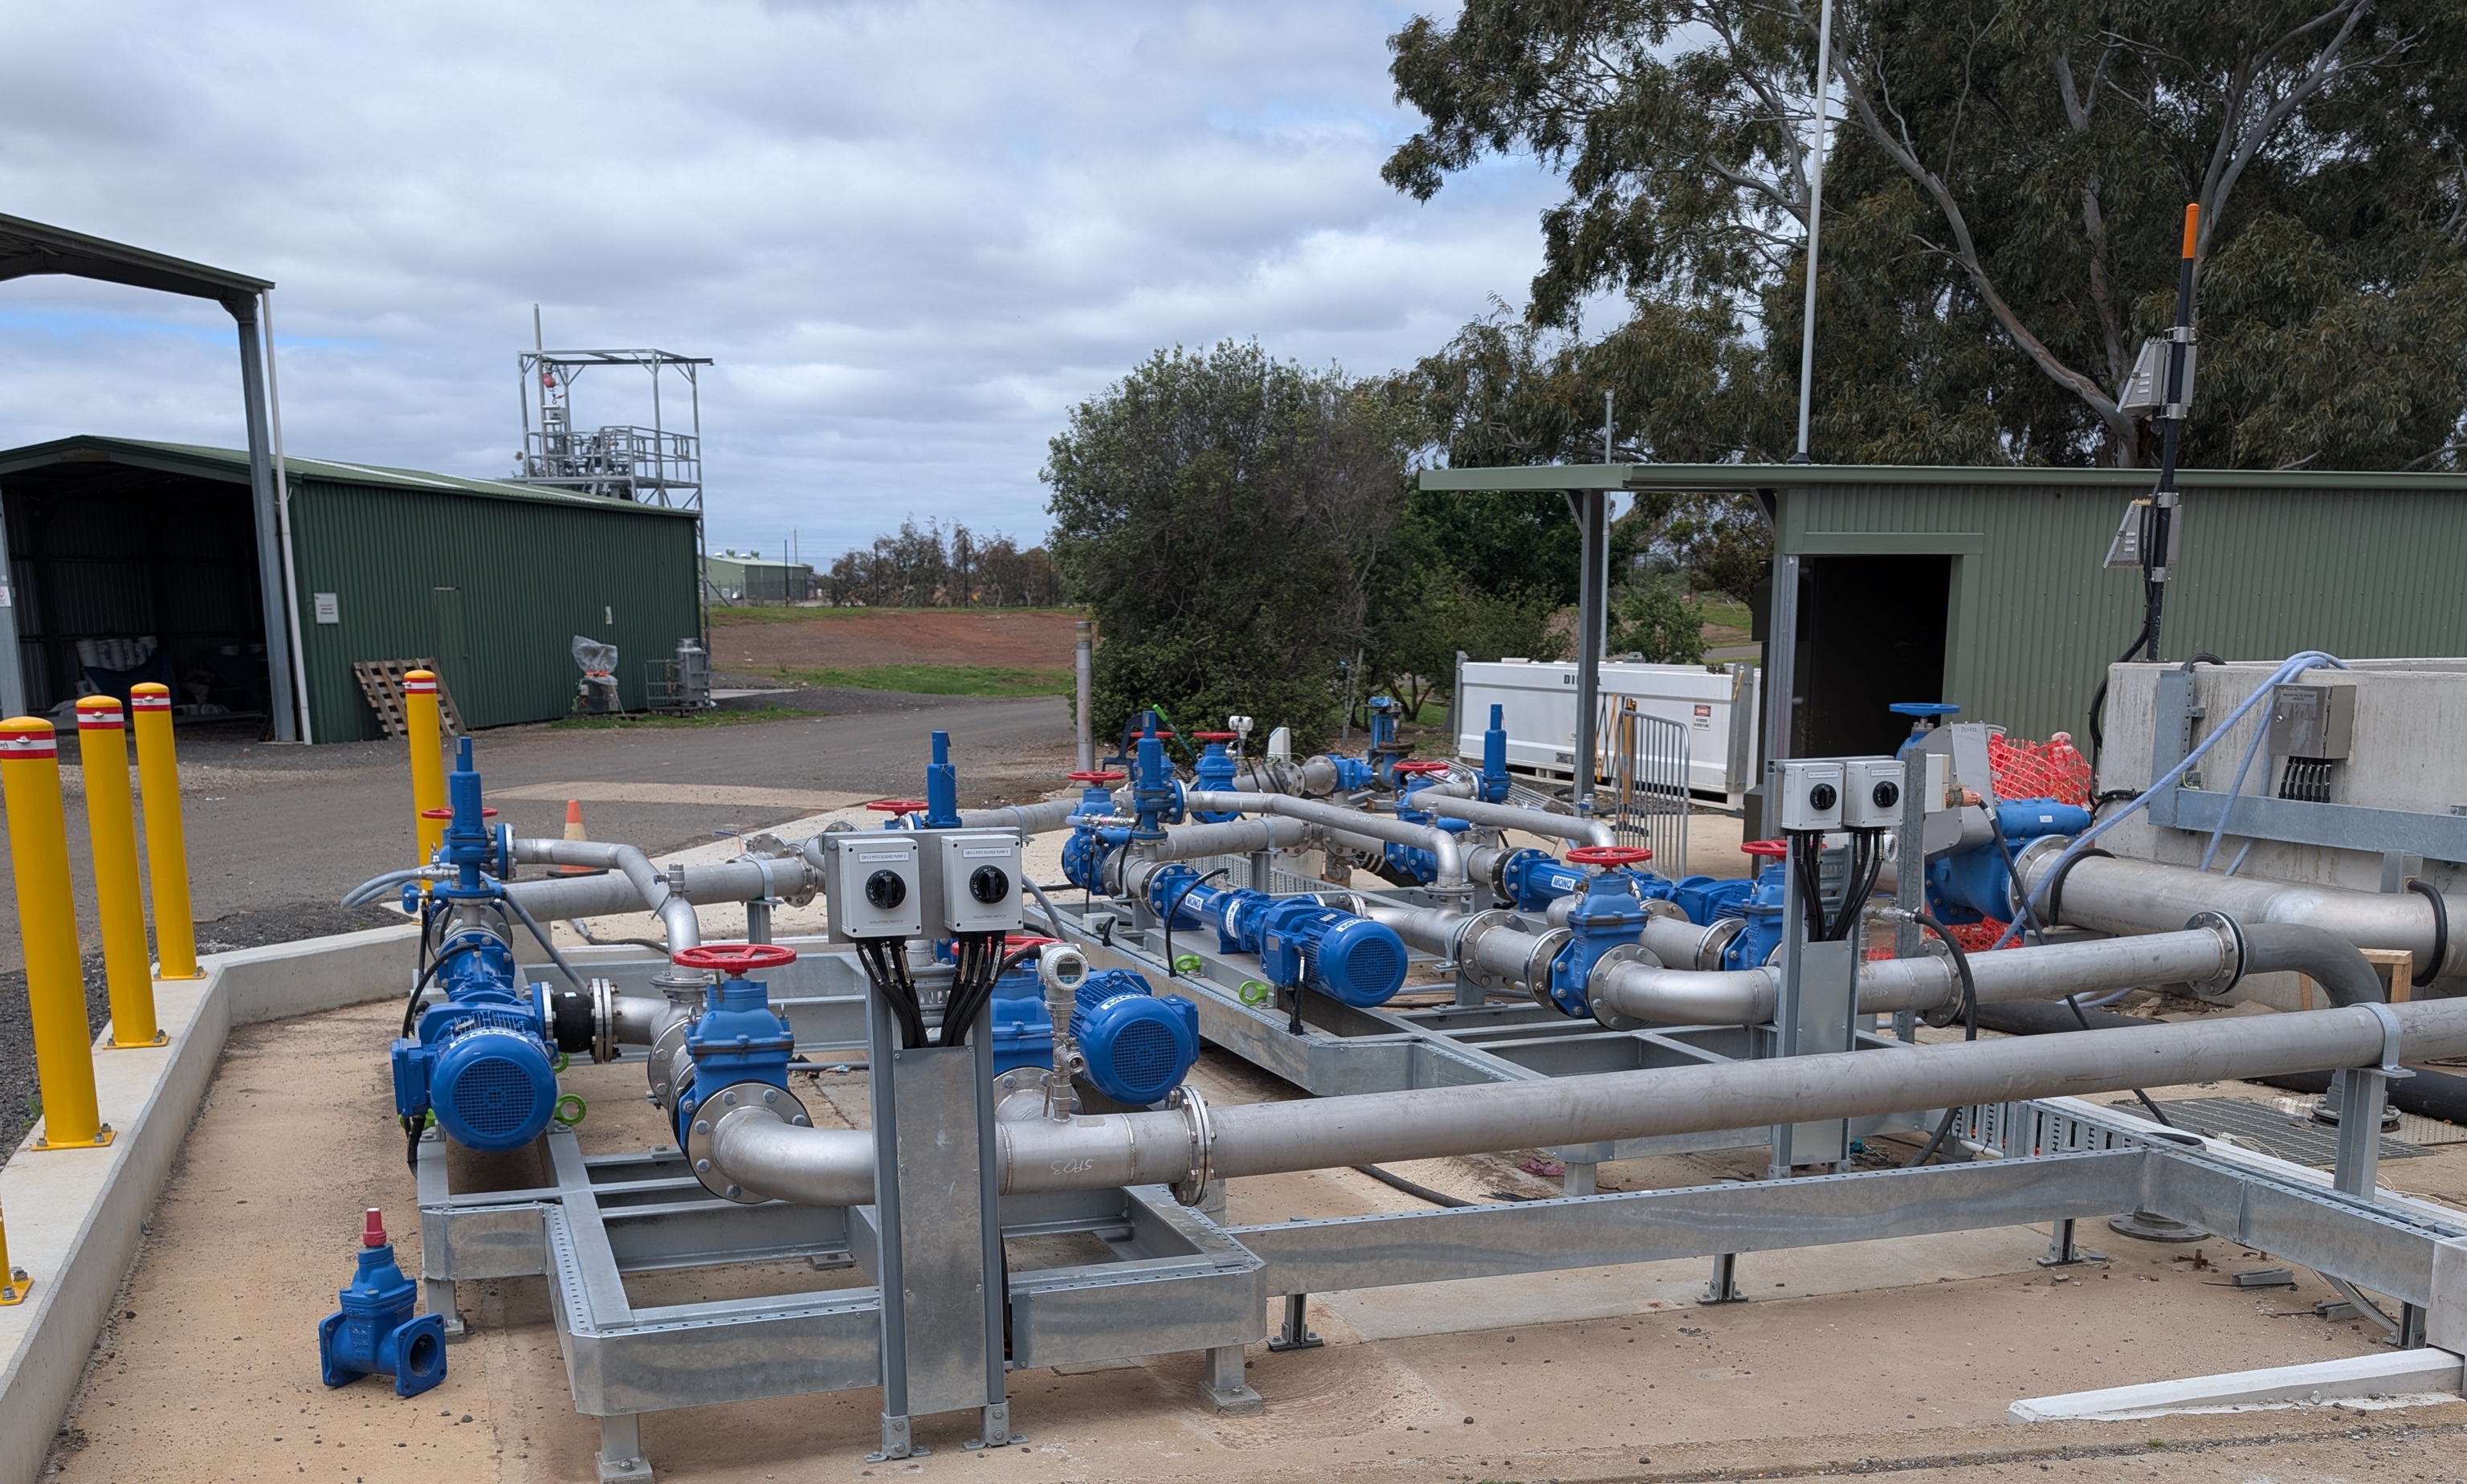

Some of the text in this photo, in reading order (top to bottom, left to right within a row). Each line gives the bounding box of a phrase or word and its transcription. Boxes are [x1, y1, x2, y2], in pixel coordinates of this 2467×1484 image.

[1552, 877, 1572, 889] MONO
[1187, 895, 1201, 909] MONO
[455, 1029, 521, 1044] MONO
